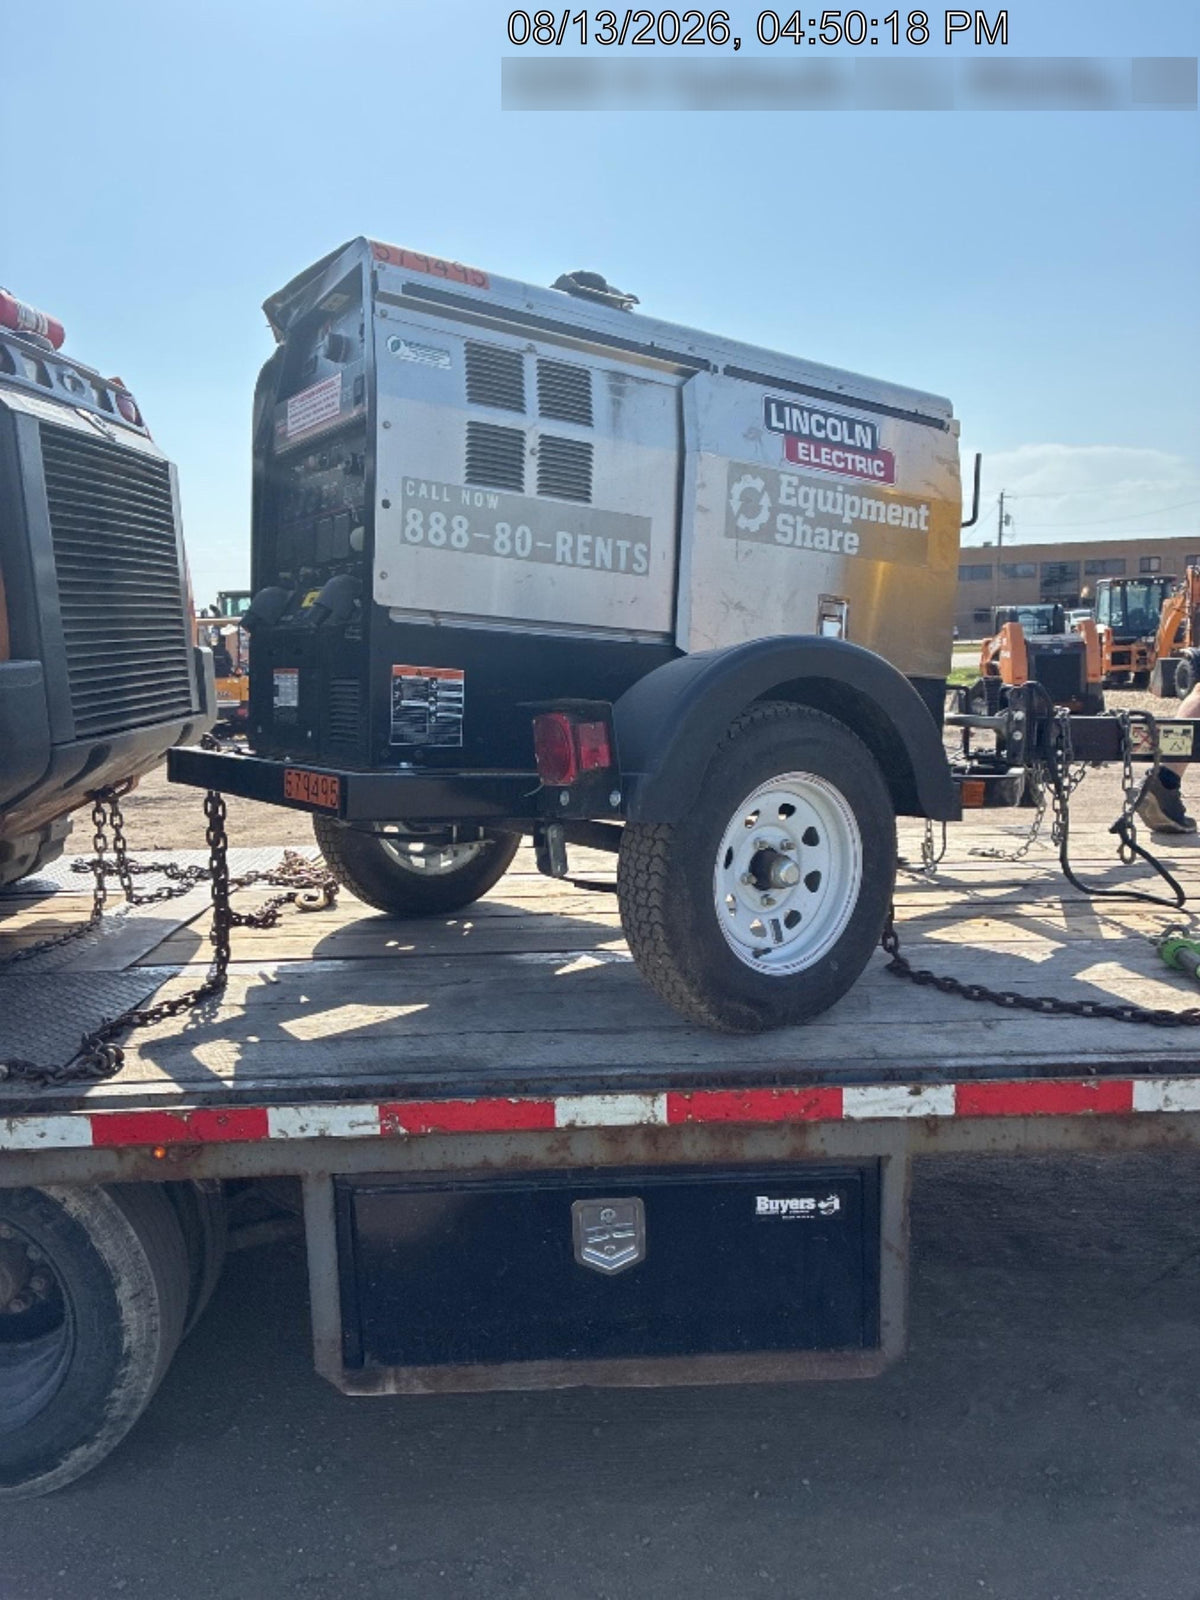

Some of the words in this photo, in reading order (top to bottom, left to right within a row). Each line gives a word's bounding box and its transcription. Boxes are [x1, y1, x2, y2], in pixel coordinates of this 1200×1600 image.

[769, 402, 874, 450] LINCOLN
[797, 441, 886, 478] ELECTRIC
[405, 479, 452, 503] CALL
[461, 488, 500, 510] NOW
[778, 473, 931, 532] Equipment
[403, 507, 650, 575] 888-80-RENTS
[774, 512, 860, 556] Share
[755, 1195, 817, 1214] Buyers
